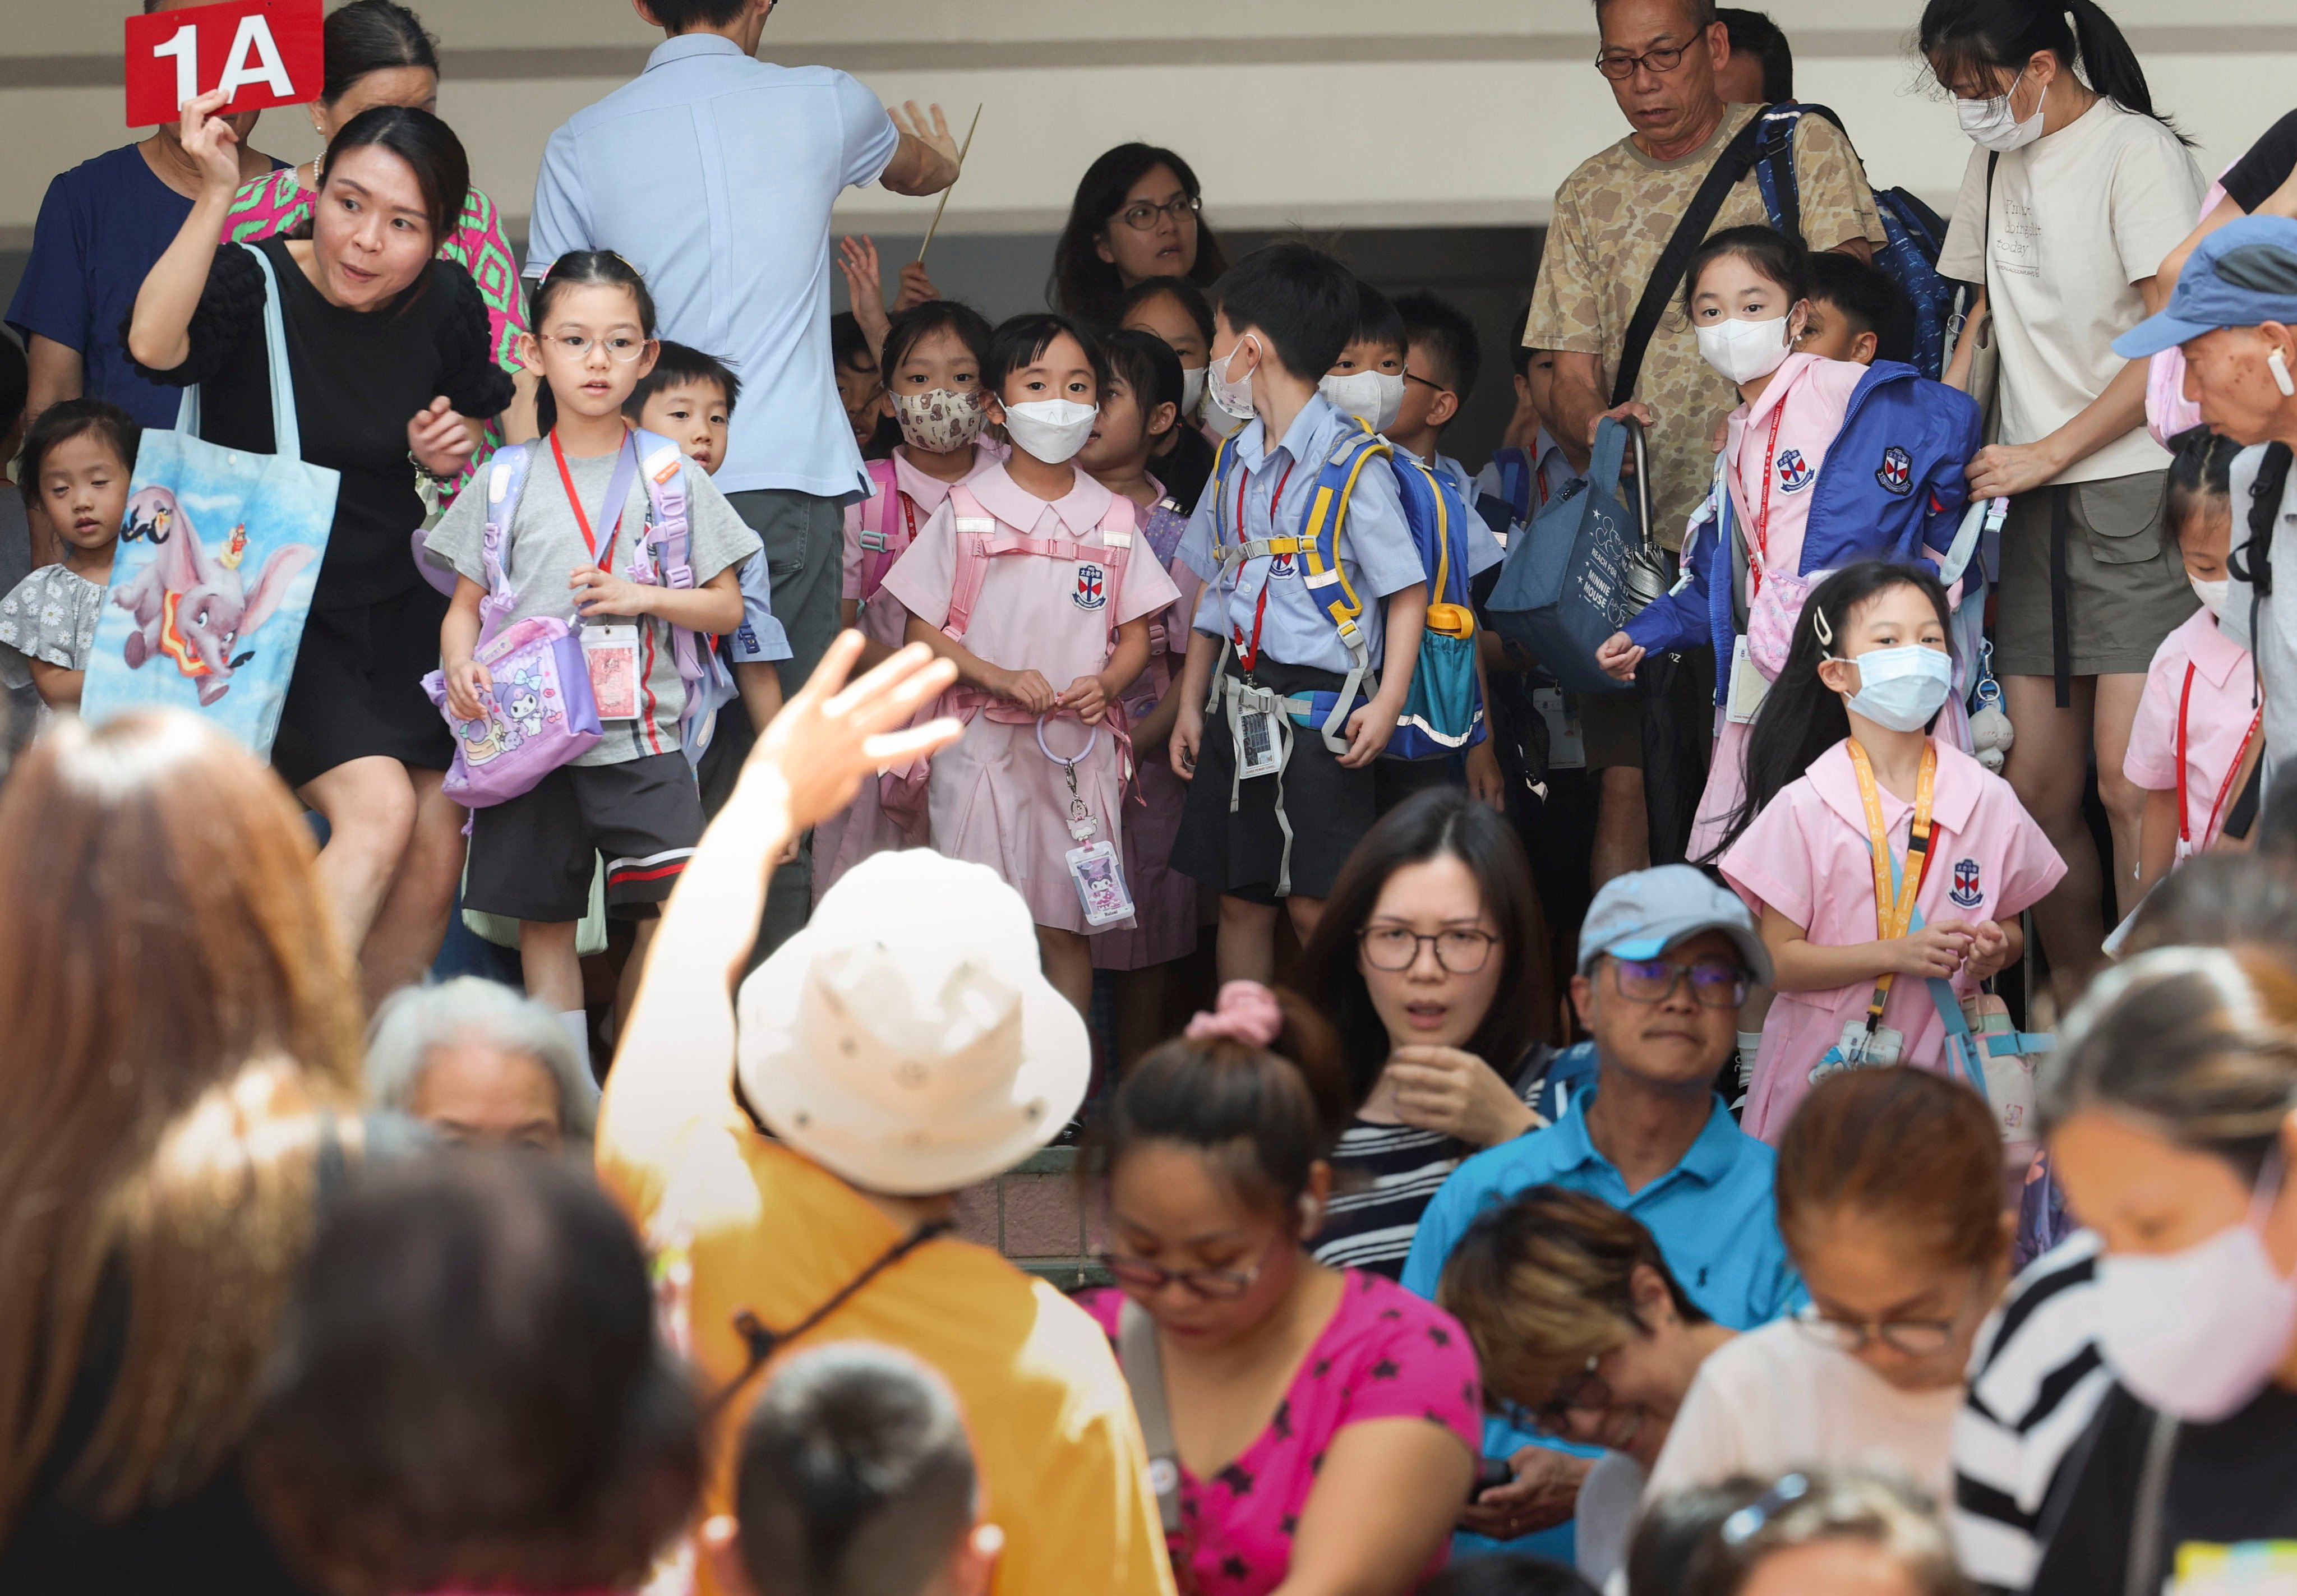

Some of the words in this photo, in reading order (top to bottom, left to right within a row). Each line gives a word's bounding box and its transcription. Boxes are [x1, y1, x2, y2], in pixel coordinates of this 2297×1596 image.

[153, 13, 295, 112] 1A
[1997, 239, 2029, 257] today
[1773, 408, 1781, 428] PRIMARY
[1081, 569, 1100, 578] 太古小學
[1592, 547, 1607, 568] REACH
[1607, 564, 1617, 578] FOR
[1583, 581, 1607, 608] MOUSE
[1588, 569, 1611, 597] MINNIE
